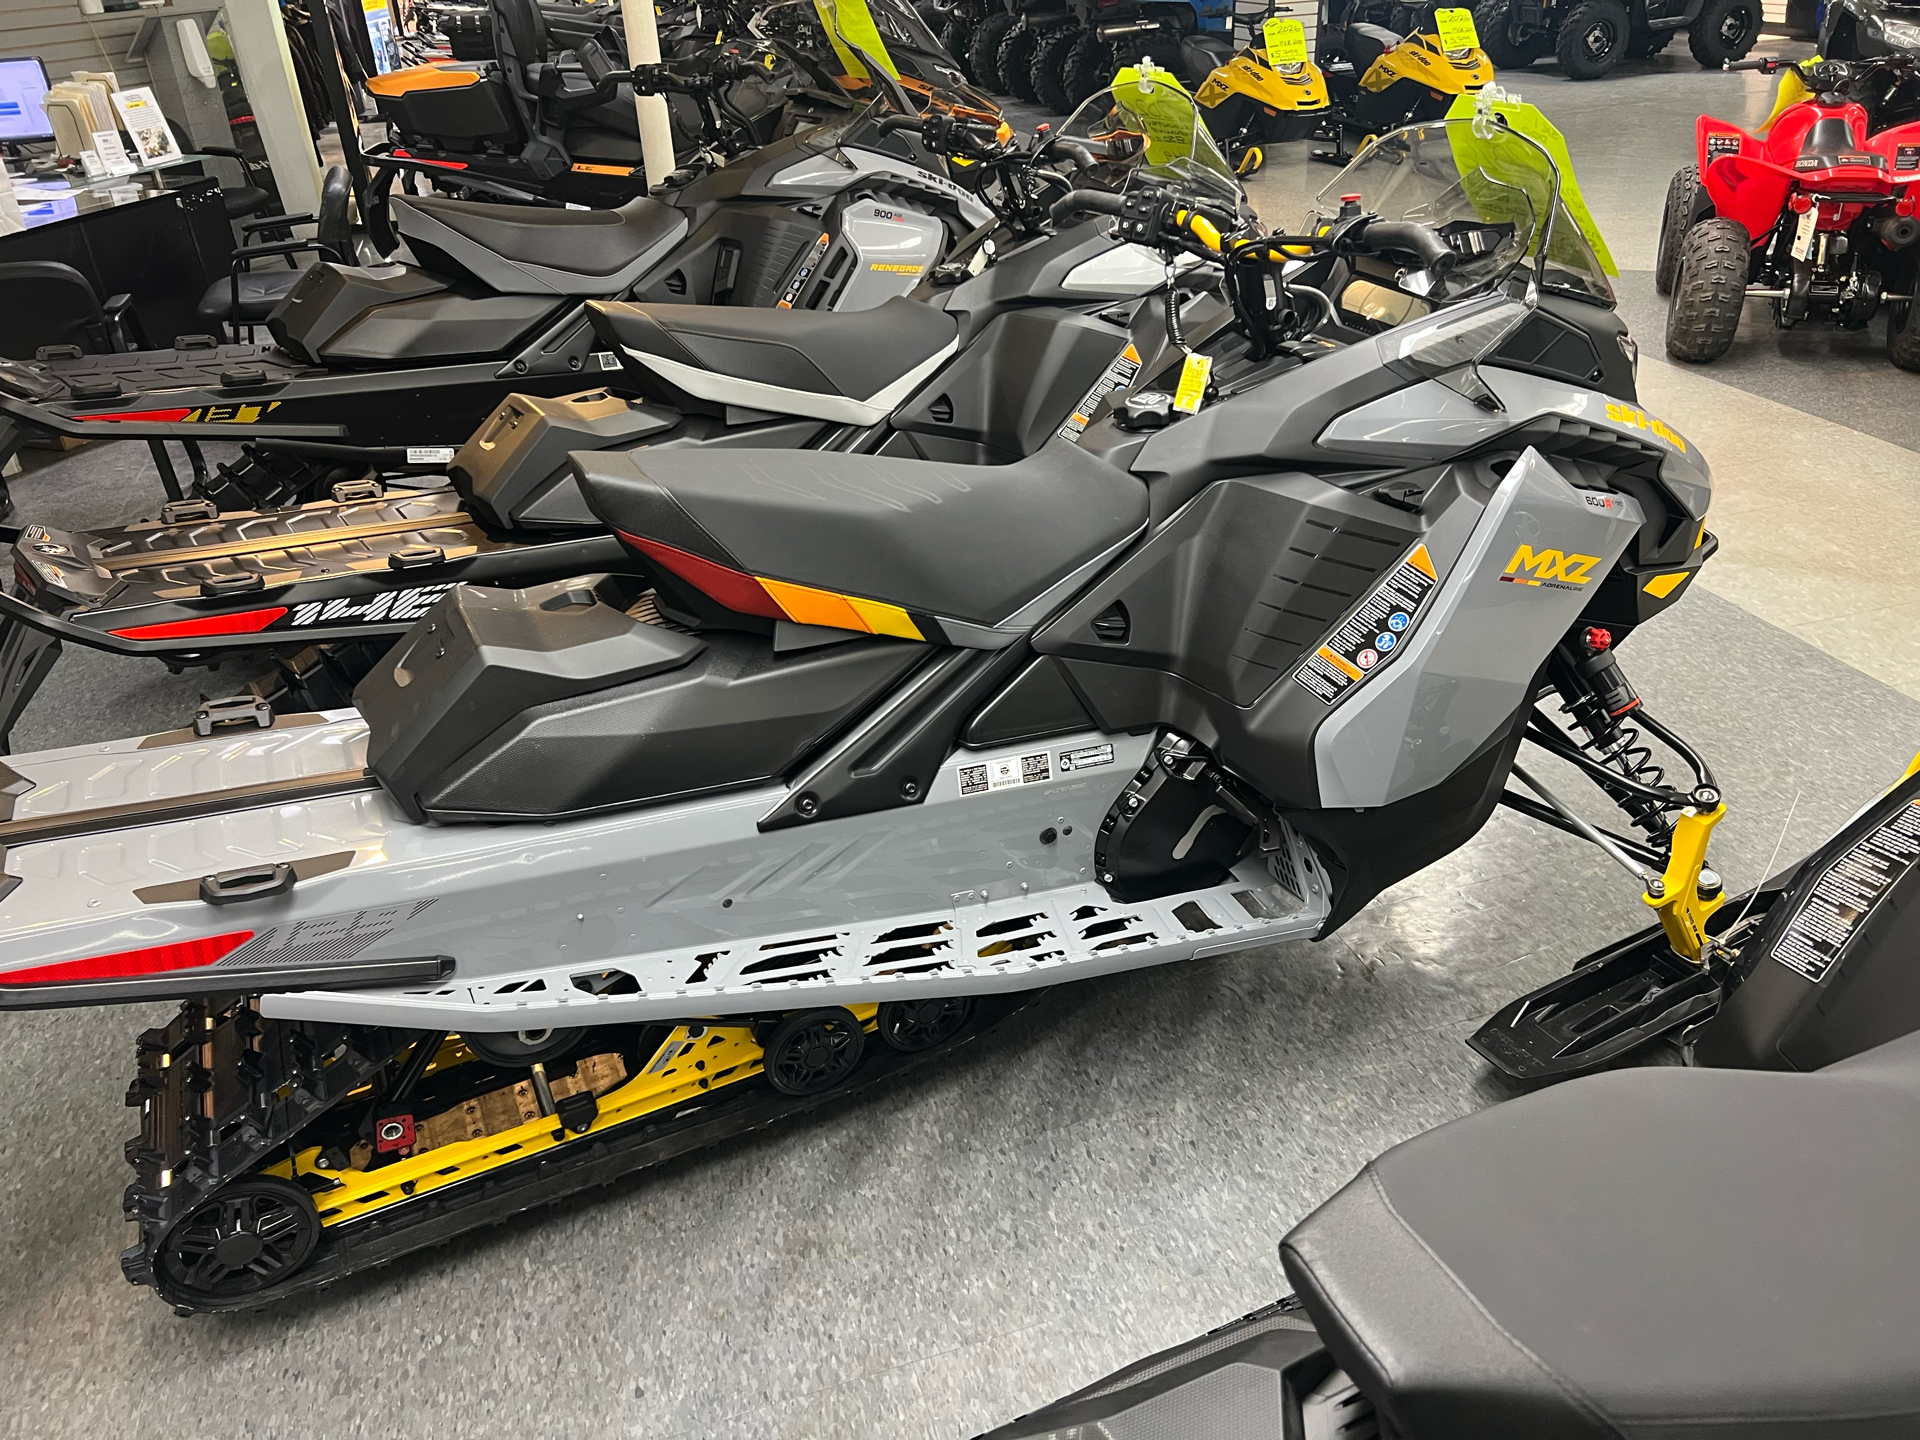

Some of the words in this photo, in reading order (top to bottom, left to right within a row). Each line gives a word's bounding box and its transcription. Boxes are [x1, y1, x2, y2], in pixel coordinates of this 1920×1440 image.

[1277, 24, 1301, 34] 2026
[1379, 64, 1397, 78] MXZ
[1211, 78, 1230, 92] MXZ
[873, 208, 893, 220] 900
[869, 263, 925, 273] RENEGADE
[1605, 403, 1687, 455] ski-doo
[1585, 496, 1613, 510] 600R
[1504, 543, 1603, 585] MXZ
[1541, 582, 1585, 592] ADRENALINE
